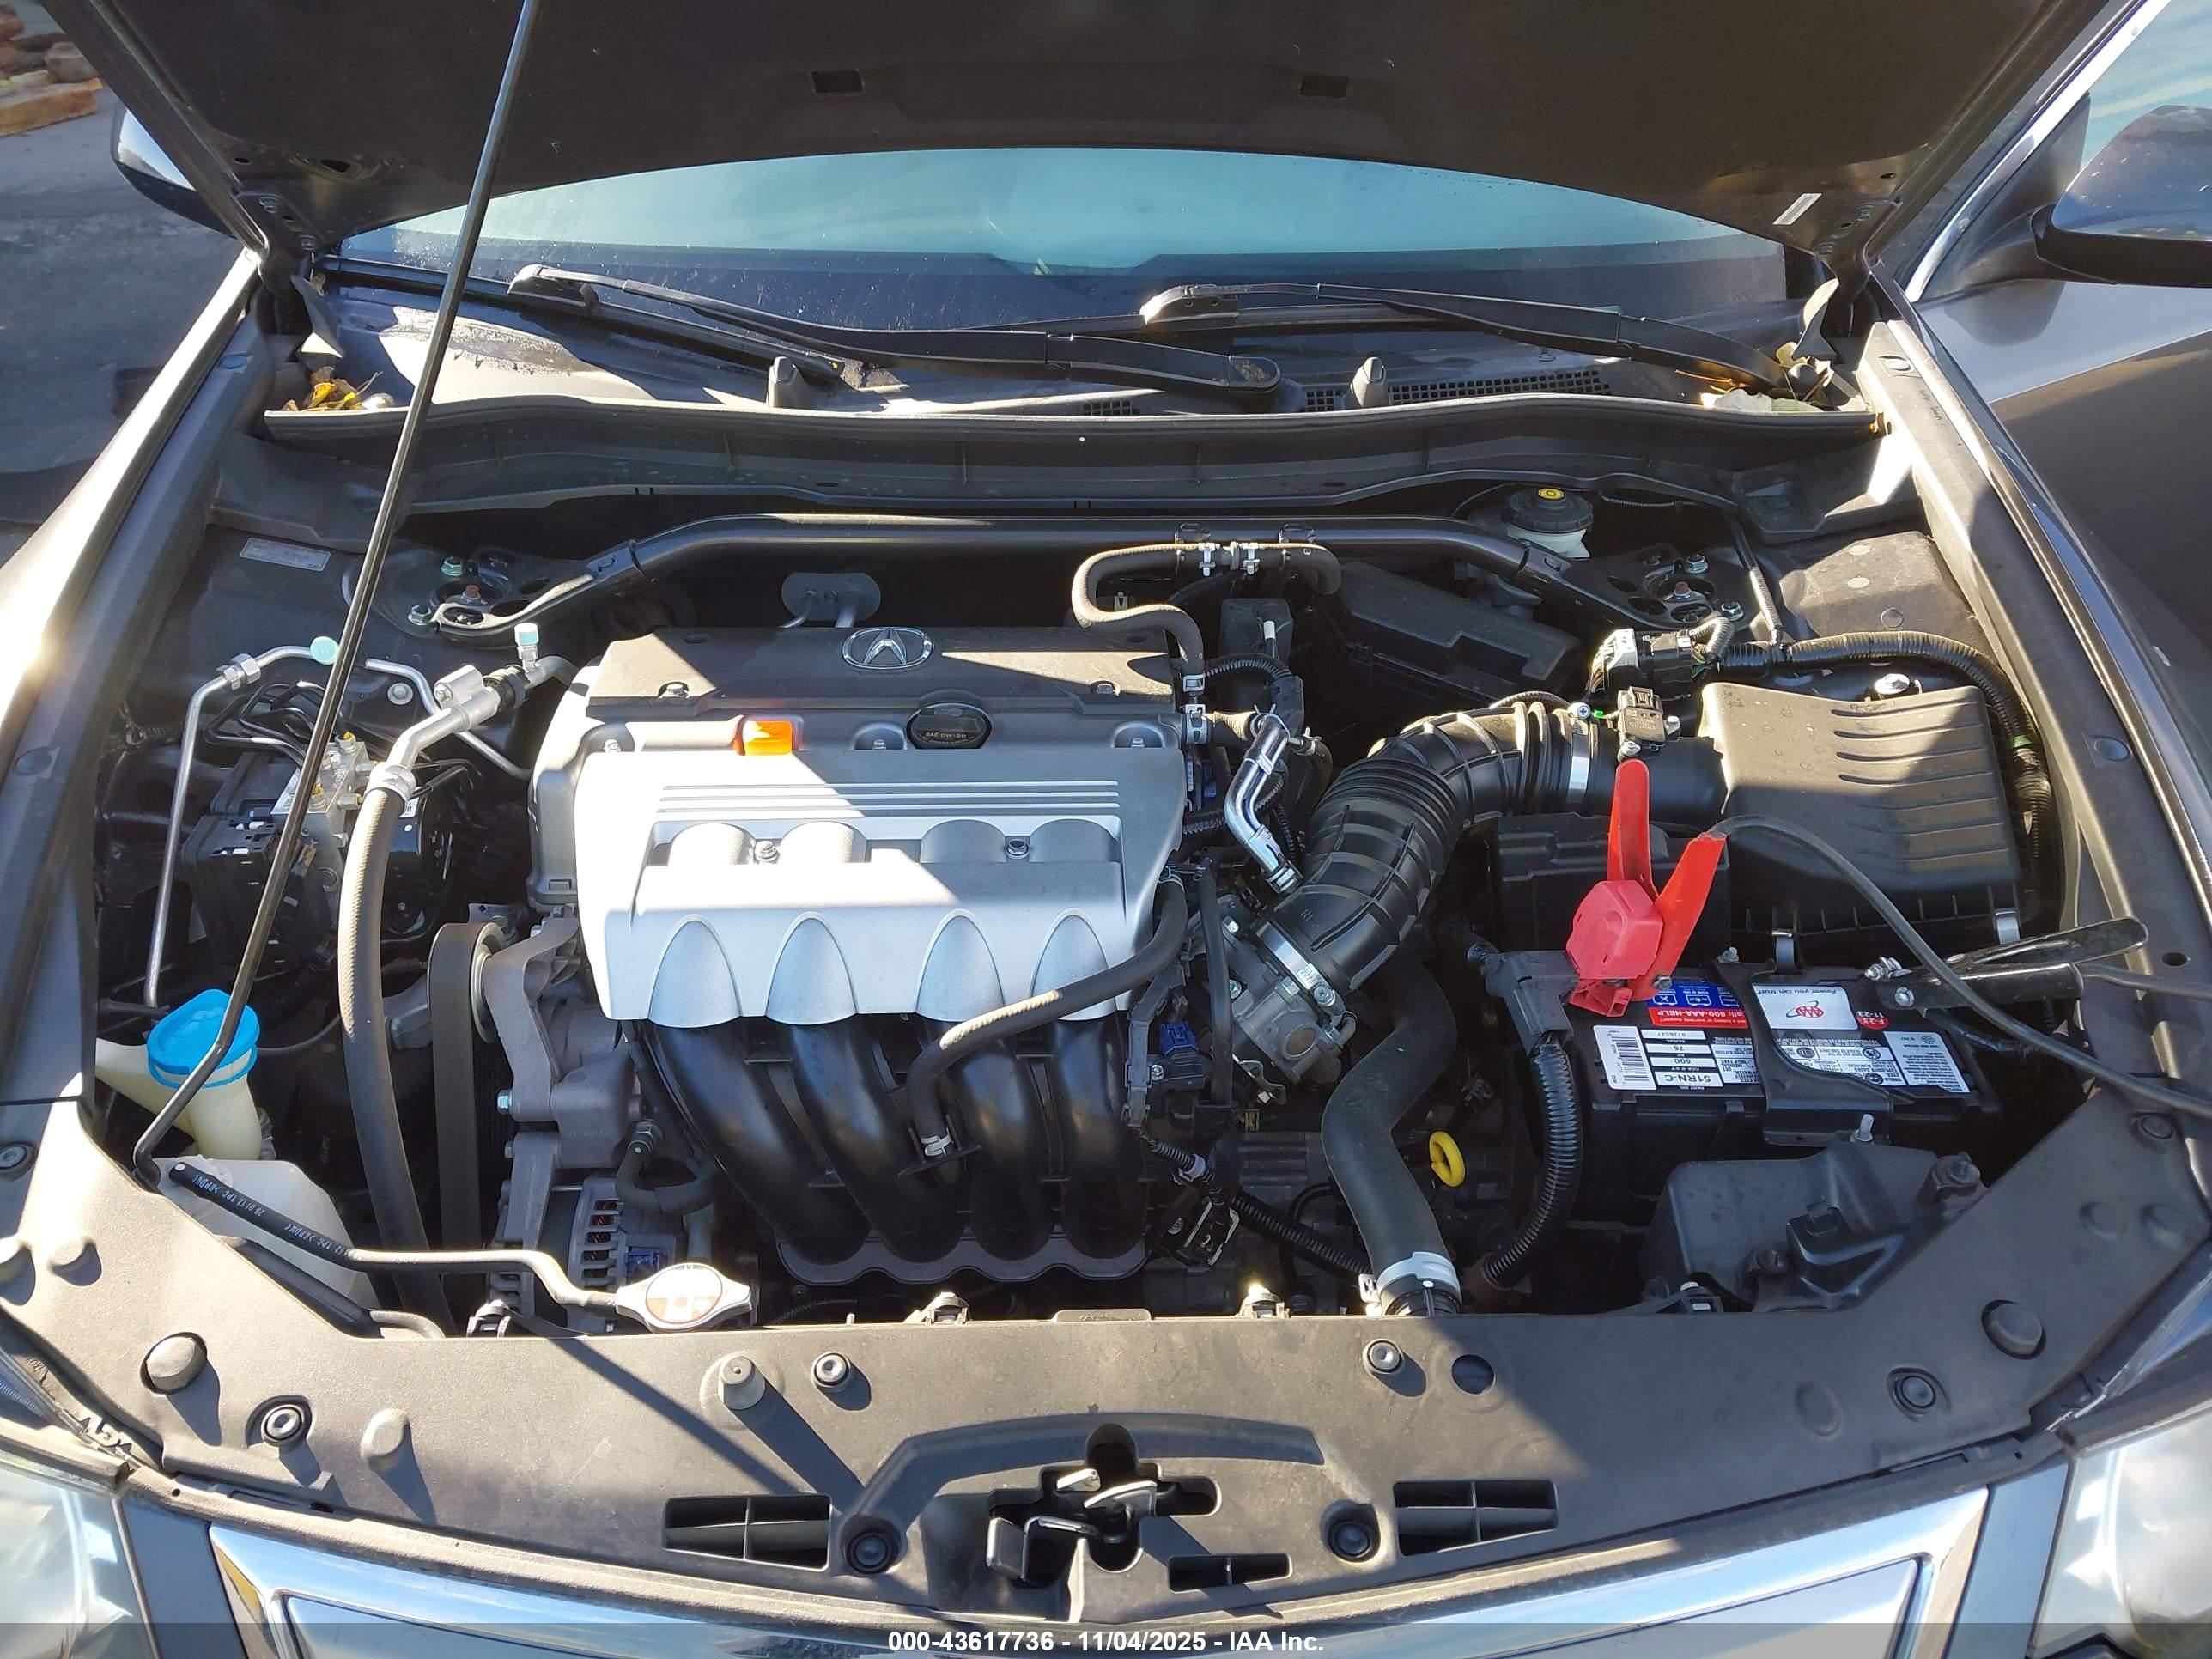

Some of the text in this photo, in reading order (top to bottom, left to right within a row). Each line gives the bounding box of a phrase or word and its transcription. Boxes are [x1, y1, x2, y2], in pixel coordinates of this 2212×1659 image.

[1796, 1006, 1823, 1018] AAA
[1664, 1074, 1711, 1083] 51RN-C
[222, 1190, 238, 1202] TPC
